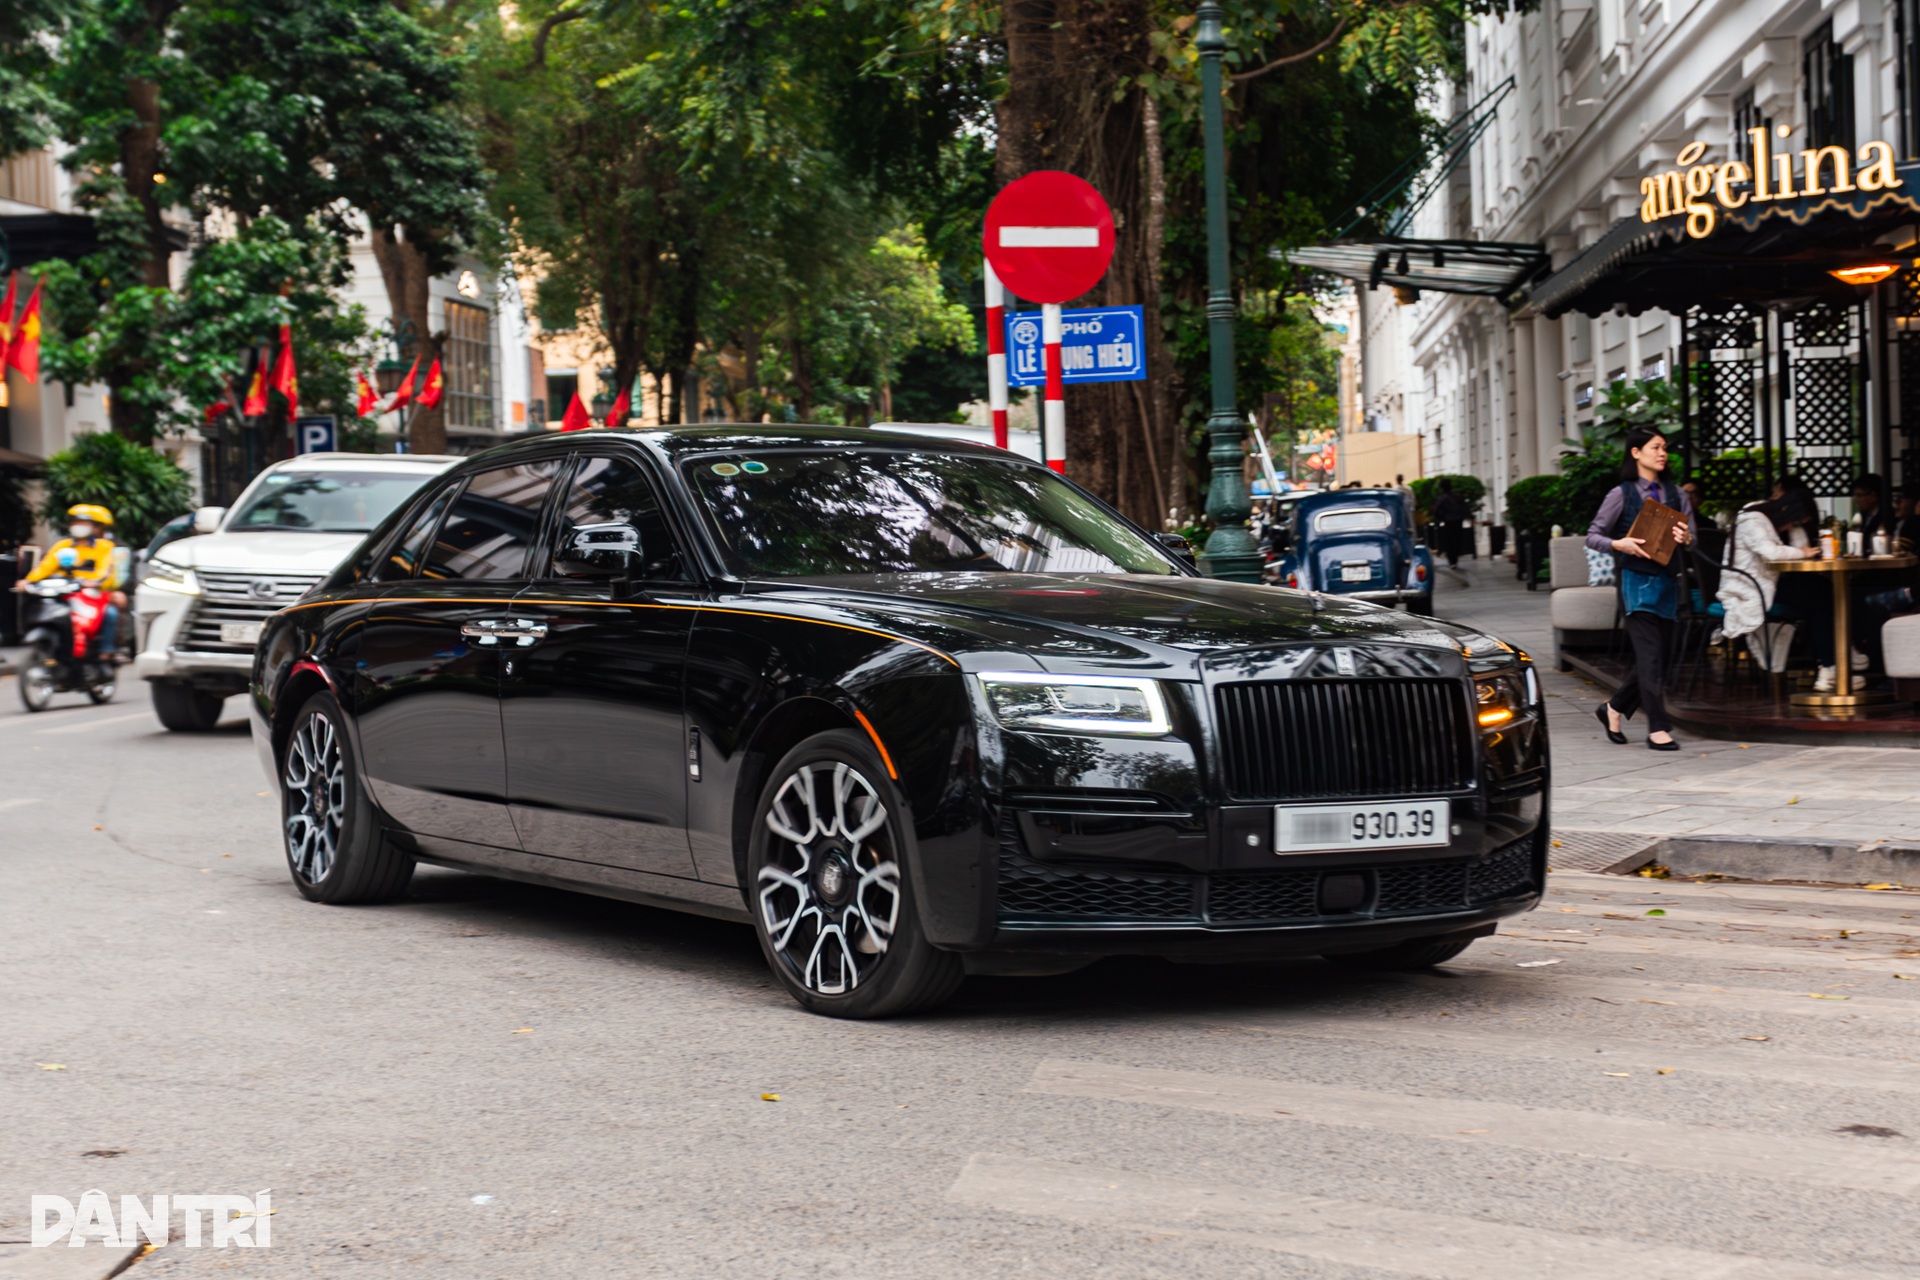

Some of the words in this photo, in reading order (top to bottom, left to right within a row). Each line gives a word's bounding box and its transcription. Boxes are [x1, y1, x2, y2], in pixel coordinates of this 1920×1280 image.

[1640, 124, 1904, 239] angelina
[1061, 316, 1103, 336] PHỐ
[1017, 344, 1038, 373] LÊ
[1041, 345, 1095, 375] ỤNG
[303, 425, 329, 453] P
[1352, 809, 1434, 840] 930.39
